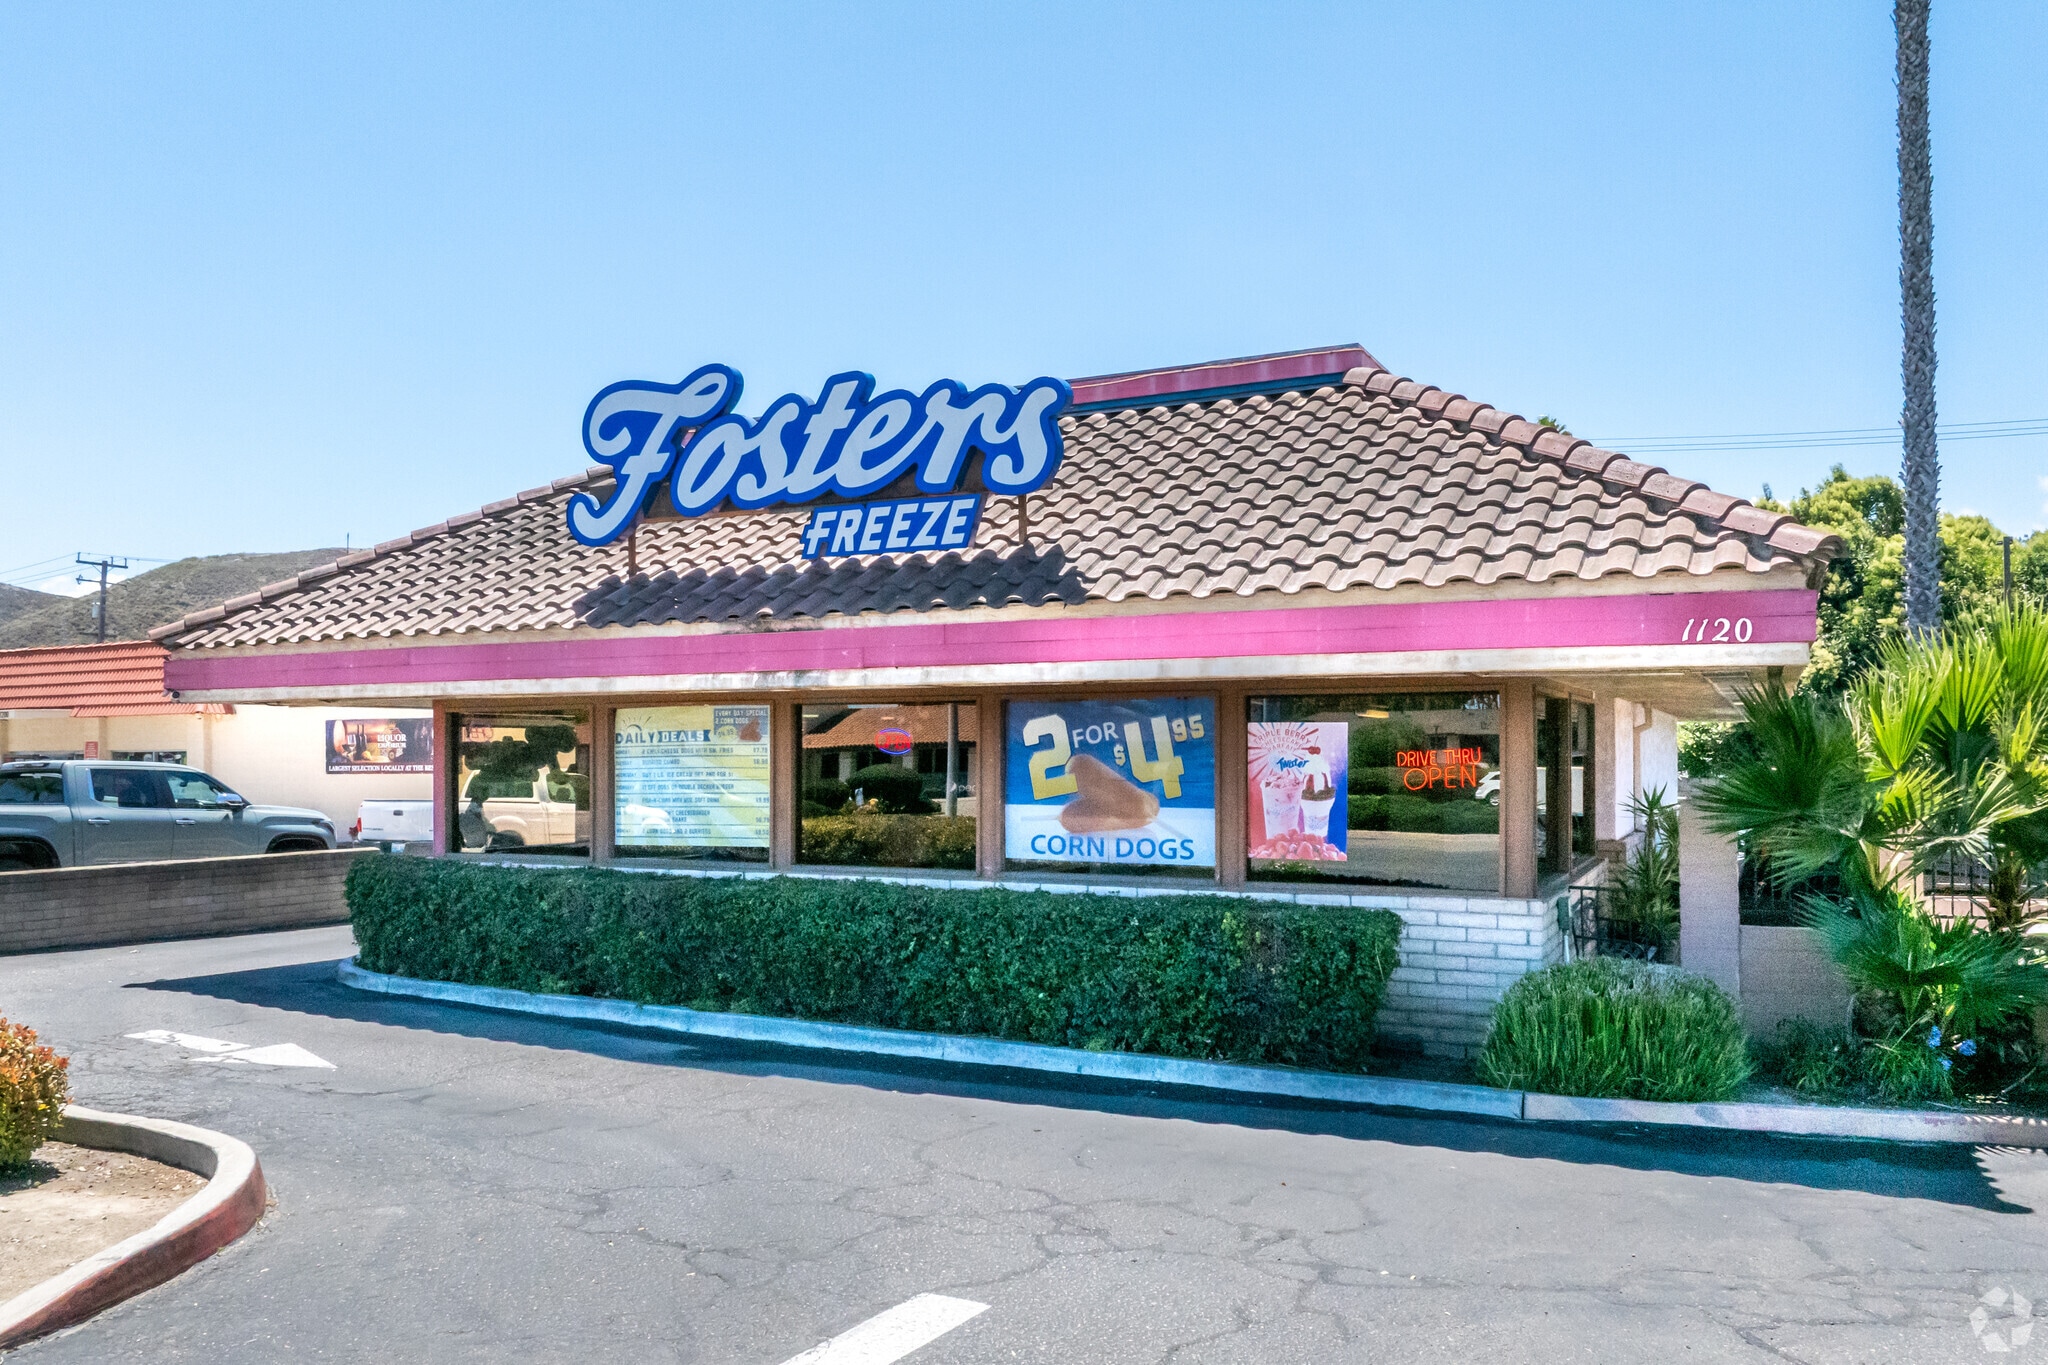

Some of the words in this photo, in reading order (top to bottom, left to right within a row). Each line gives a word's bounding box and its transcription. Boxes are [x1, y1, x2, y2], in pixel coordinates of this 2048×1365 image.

[570, 368, 1061, 542] Fosters
[804, 497, 977, 555] FREEZE
[1681, 617, 1753, 643] 1120
[377, 733, 407, 743] LIQUOR
[615, 731, 656, 744] DAILY
[661, 730, 705, 743] DEALS
[1253, 728, 1281, 745] TRIPLE
[1284, 728, 1311, 745] BERRY
[1022, 713, 1079, 800] 2
[1072, 721, 1120, 748] FOR
[1396, 749, 1438, 767] DRIVE
[1443, 746, 1482, 765] THRU
[1403, 763, 1477, 791] OPEN
[1030, 834, 1105, 857] CORN
[1115, 837, 1195, 860] DOGS
